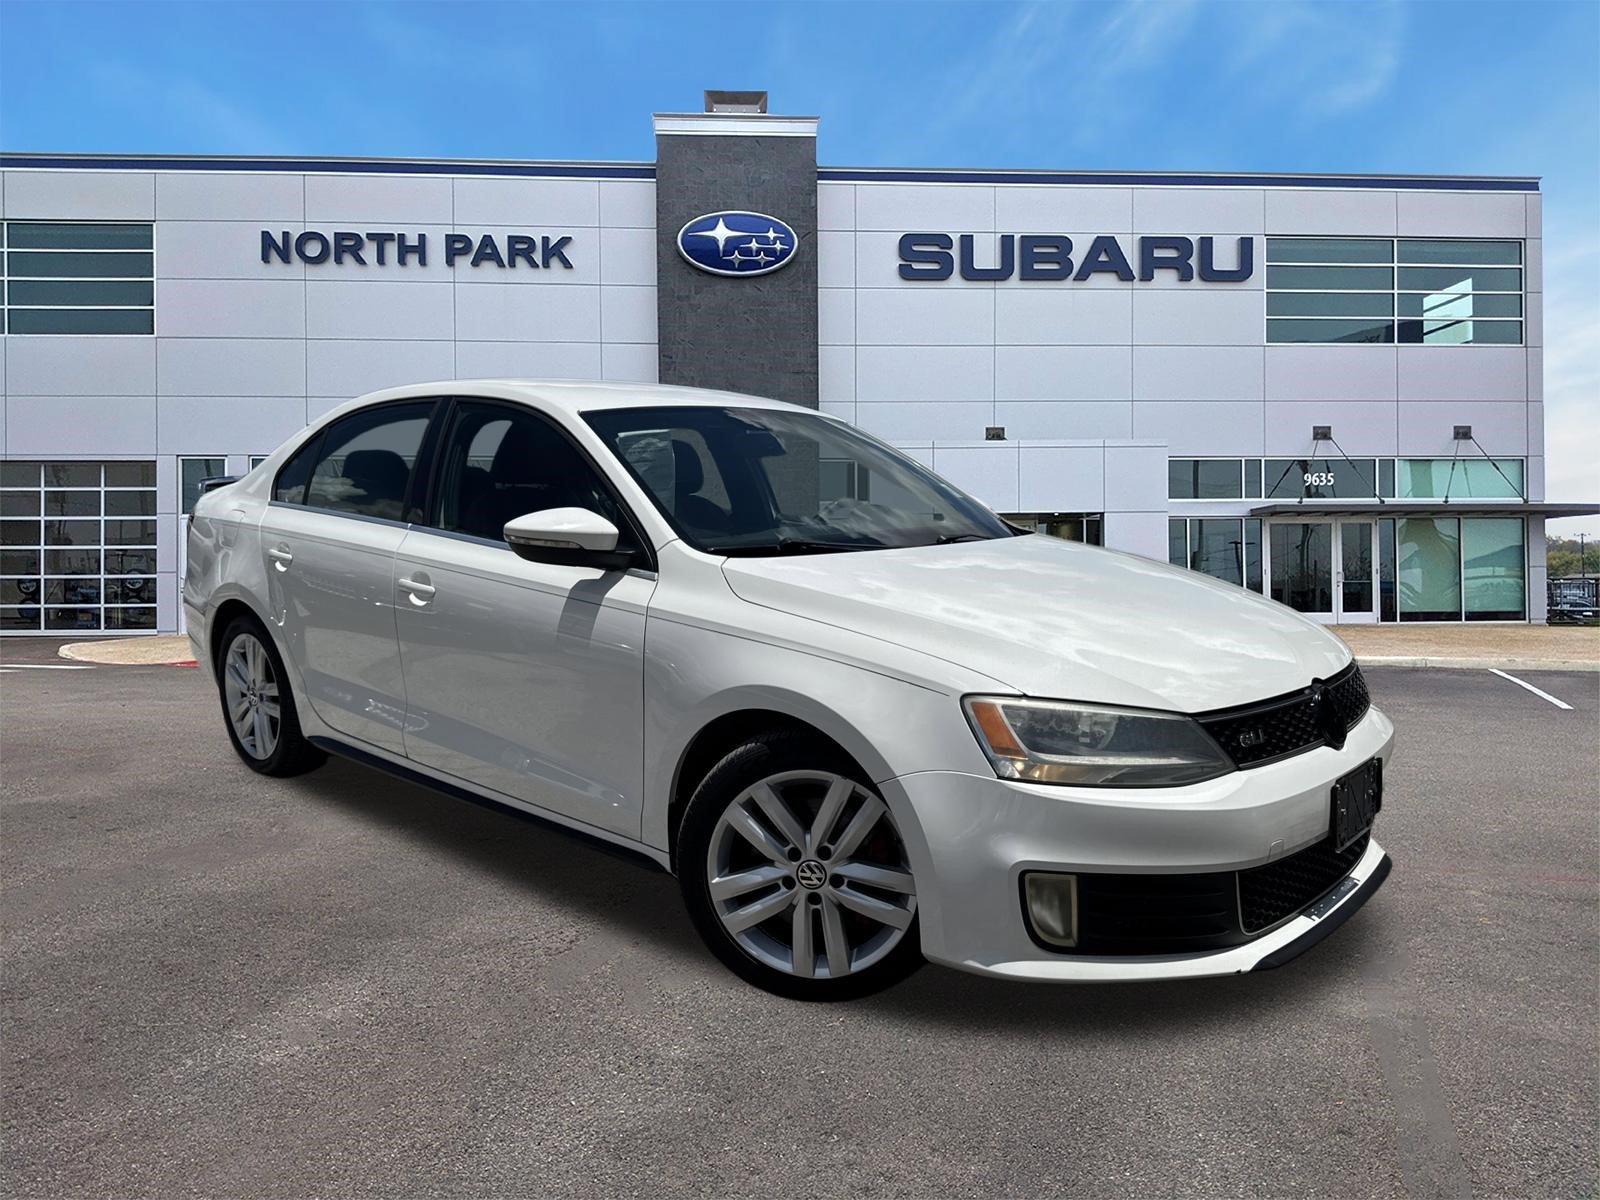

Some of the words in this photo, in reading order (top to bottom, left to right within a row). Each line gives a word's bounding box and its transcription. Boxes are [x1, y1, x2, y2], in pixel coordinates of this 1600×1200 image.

[261, 230, 427, 266] NORTH
[445, 233, 574, 269] PARK
[898, 233, 1254, 282] SUBARU
[1304, 472, 1335, 486] 9635
